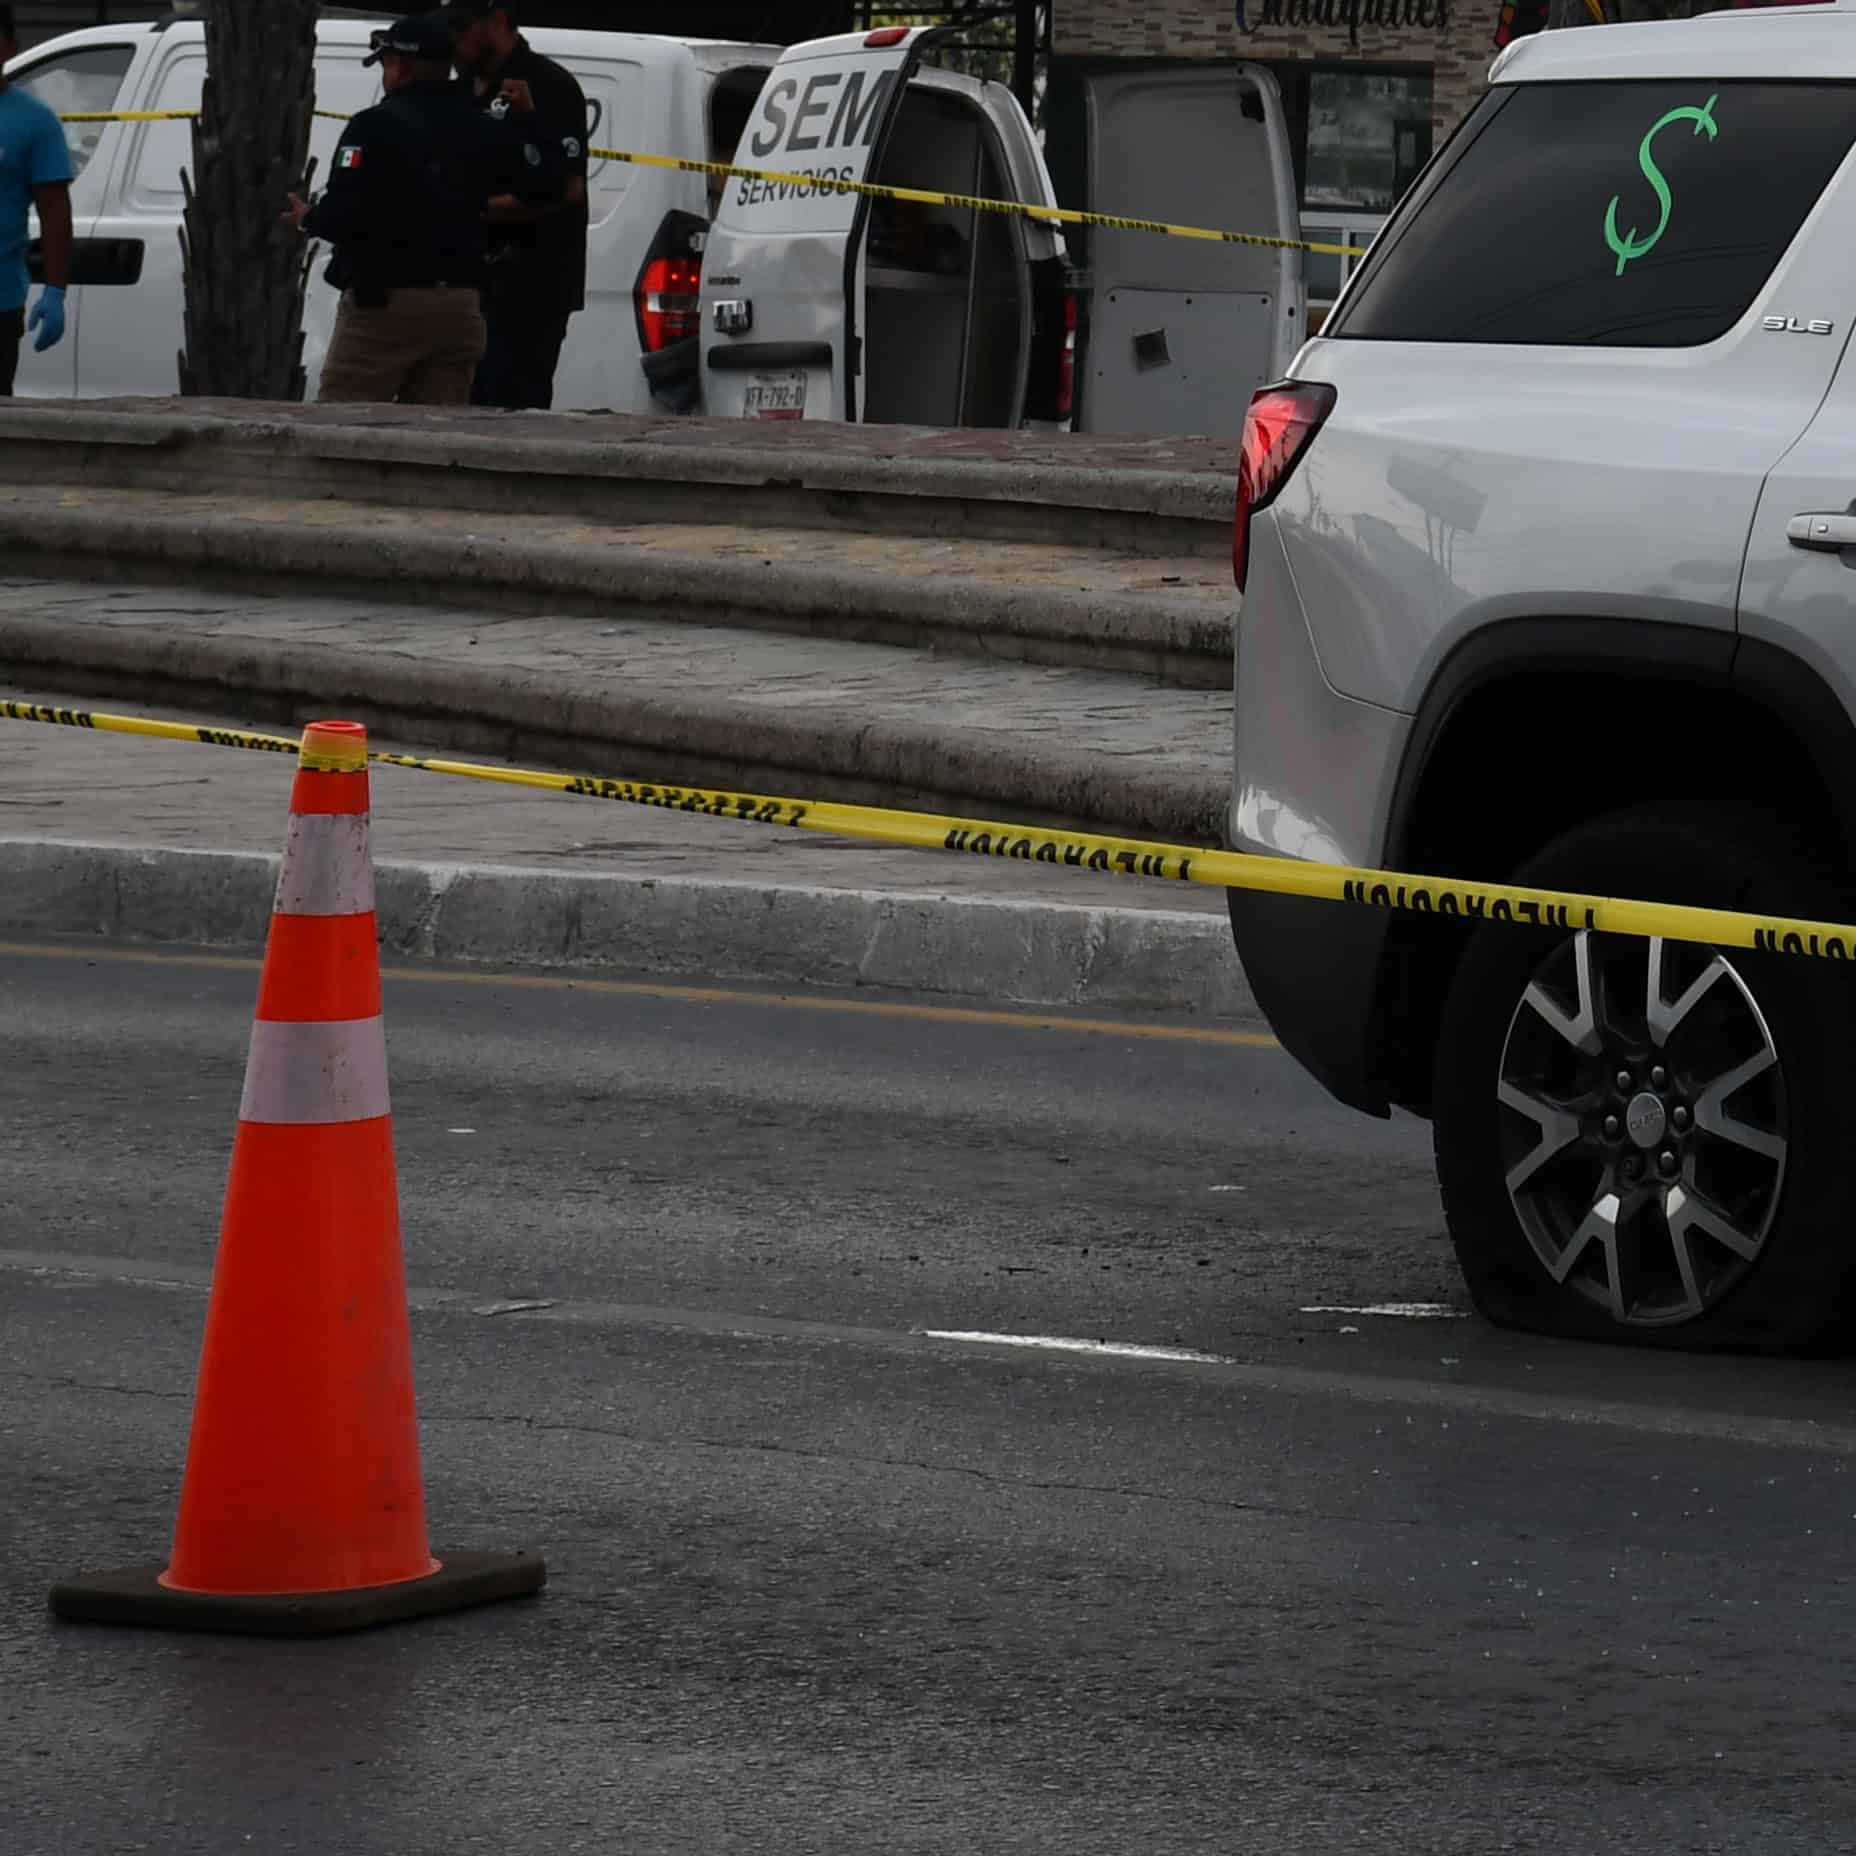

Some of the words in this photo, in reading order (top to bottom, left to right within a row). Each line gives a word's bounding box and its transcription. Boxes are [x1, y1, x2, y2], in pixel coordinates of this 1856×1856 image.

[752, 70, 900, 157] SEM
[737, 166, 854, 207] SERVICIOS
[1604, 94, 1719, 277] $
[1762, 315, 1834, 336] SLE
